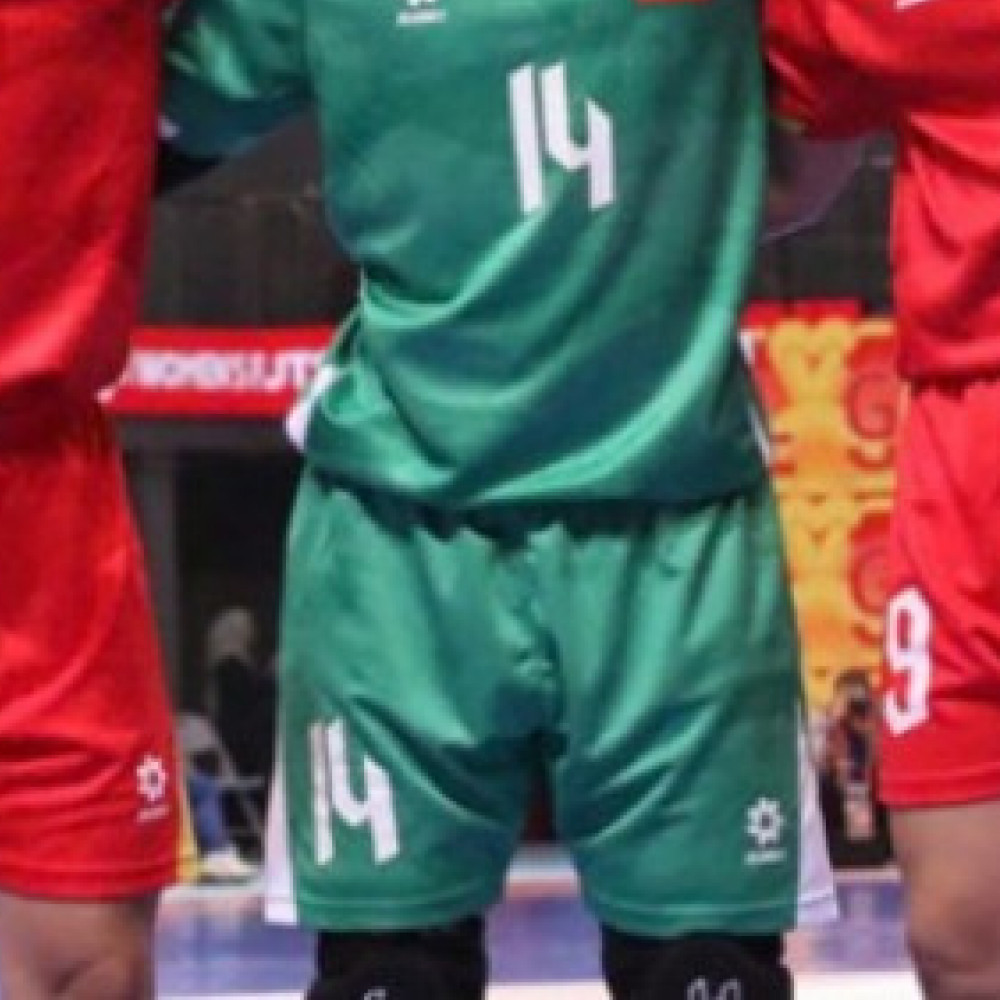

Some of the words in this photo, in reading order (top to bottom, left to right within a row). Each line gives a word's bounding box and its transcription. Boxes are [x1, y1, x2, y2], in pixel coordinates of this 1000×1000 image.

[508, 62, 615, 212] 14
[882, 587, 932, 733] 9
[310, 716, 400, 865] 14
